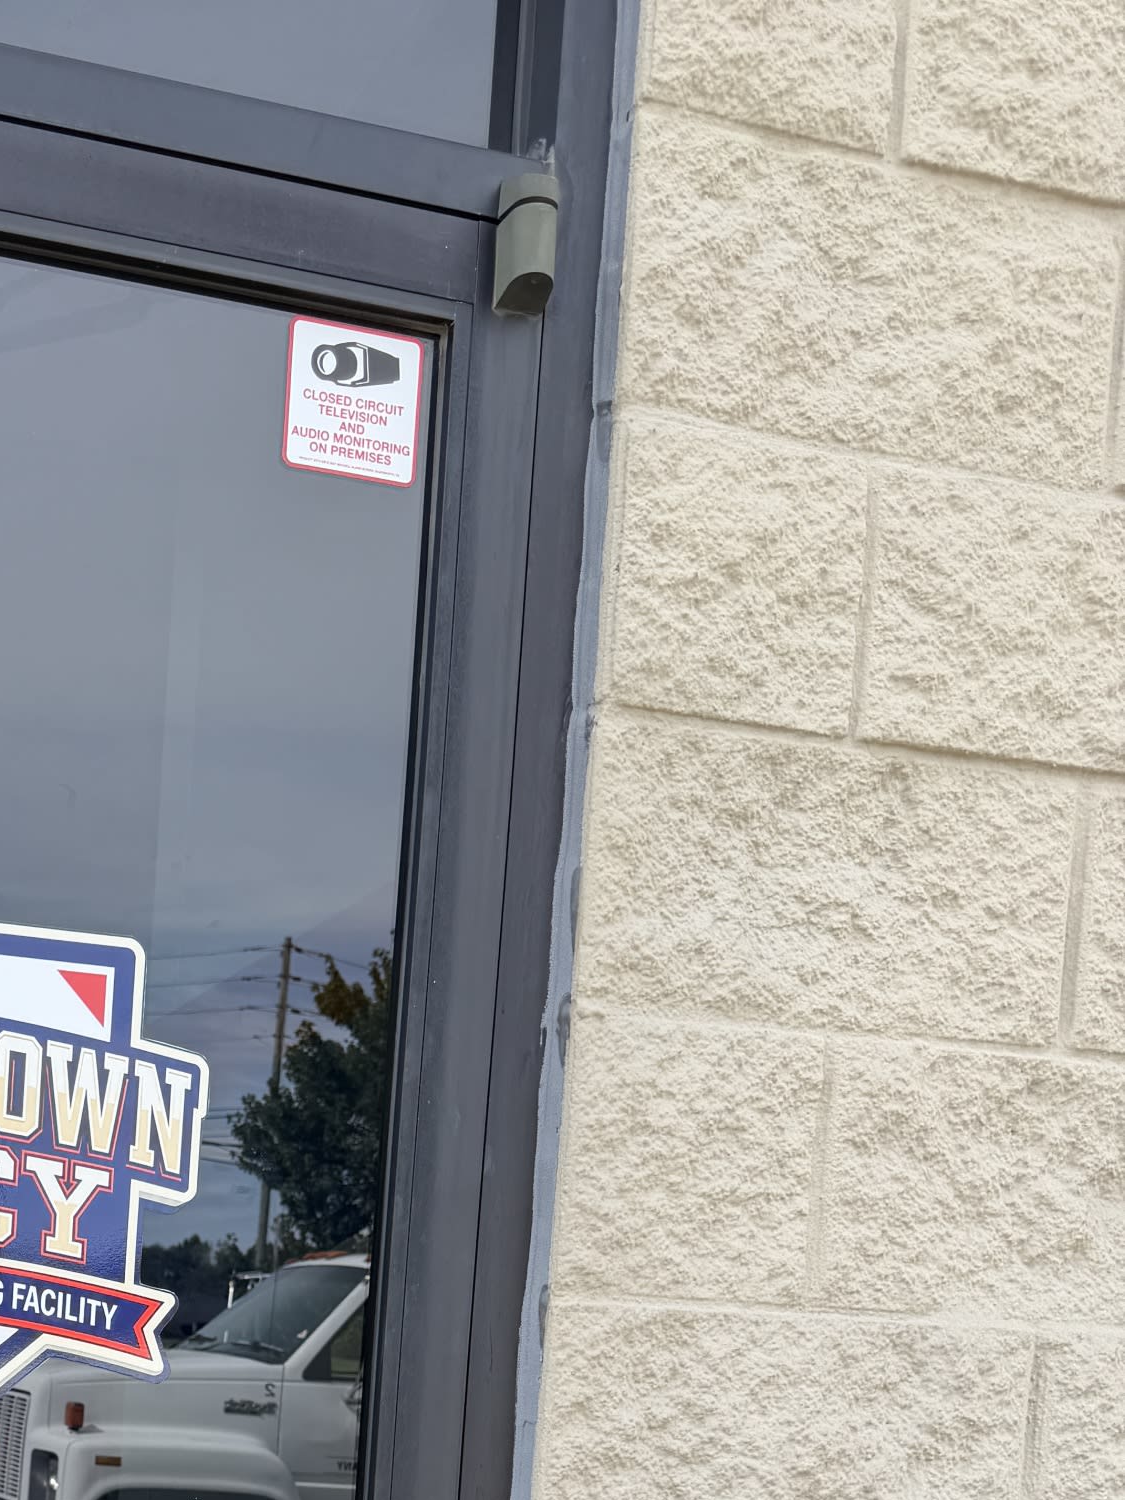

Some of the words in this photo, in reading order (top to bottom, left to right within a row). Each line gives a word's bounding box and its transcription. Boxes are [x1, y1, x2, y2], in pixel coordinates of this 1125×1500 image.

[303, 388, 352, 406] CLOSED
[355, 399, 404, 416] CIRCUIT
[318, 404, 388, 426] TELEVISION
[291, 425, 330, 441] AUDIO
[333, 434, 411, 456] MONITORING
[338, 422, 365, 435] AND
[309, 441, 327, 454] ON
[330, 444, 392, 466] PREMISES
[12, 1282, 118, 1330] FACILITY
